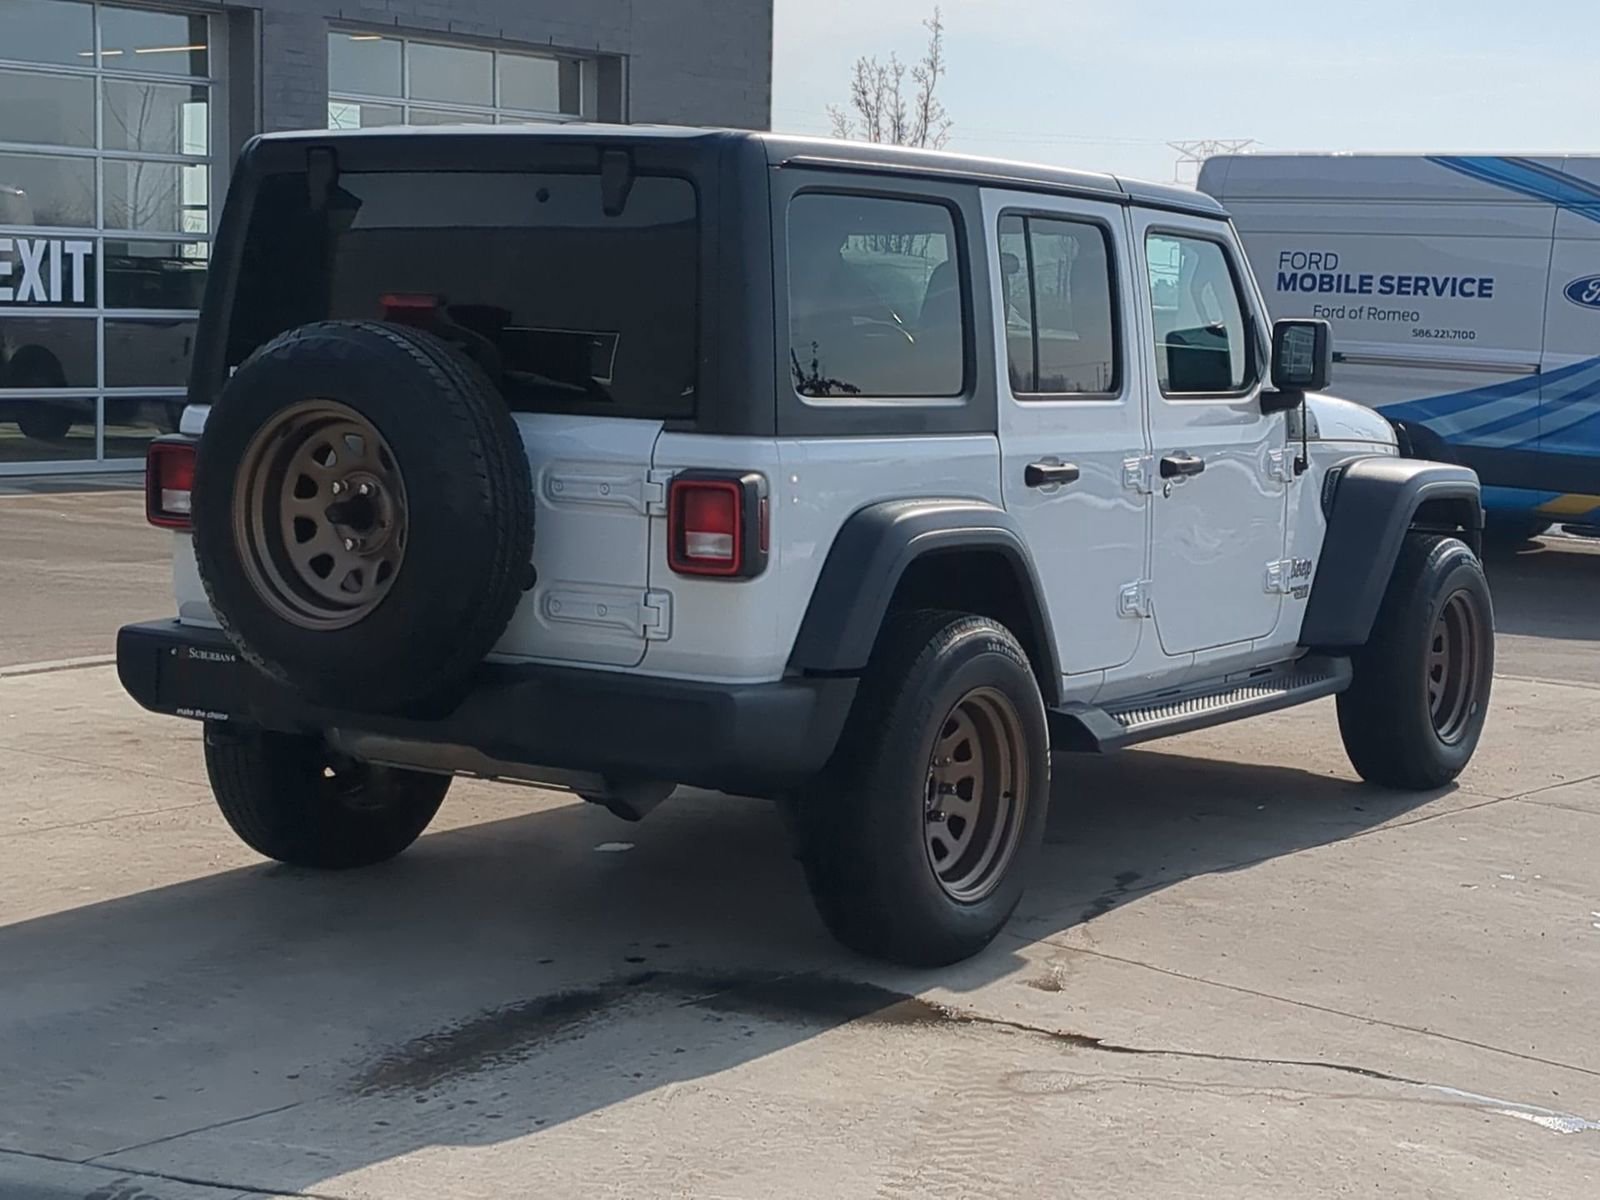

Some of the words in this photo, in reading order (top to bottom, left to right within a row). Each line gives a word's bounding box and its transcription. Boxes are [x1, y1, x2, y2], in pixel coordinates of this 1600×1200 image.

[1278, 251, 1339, 271] FORD
[1276, 272, 1374, 295] MOBILE
[1377, 275, 1494, 298] SERVICE
[1313, 304, 1345, 319] Ford
[1348, 306, 1364, 320] of
[1367, 307, 1420, 322] Romeo
[1411, 328, 1476, 340] 586.221.7100
